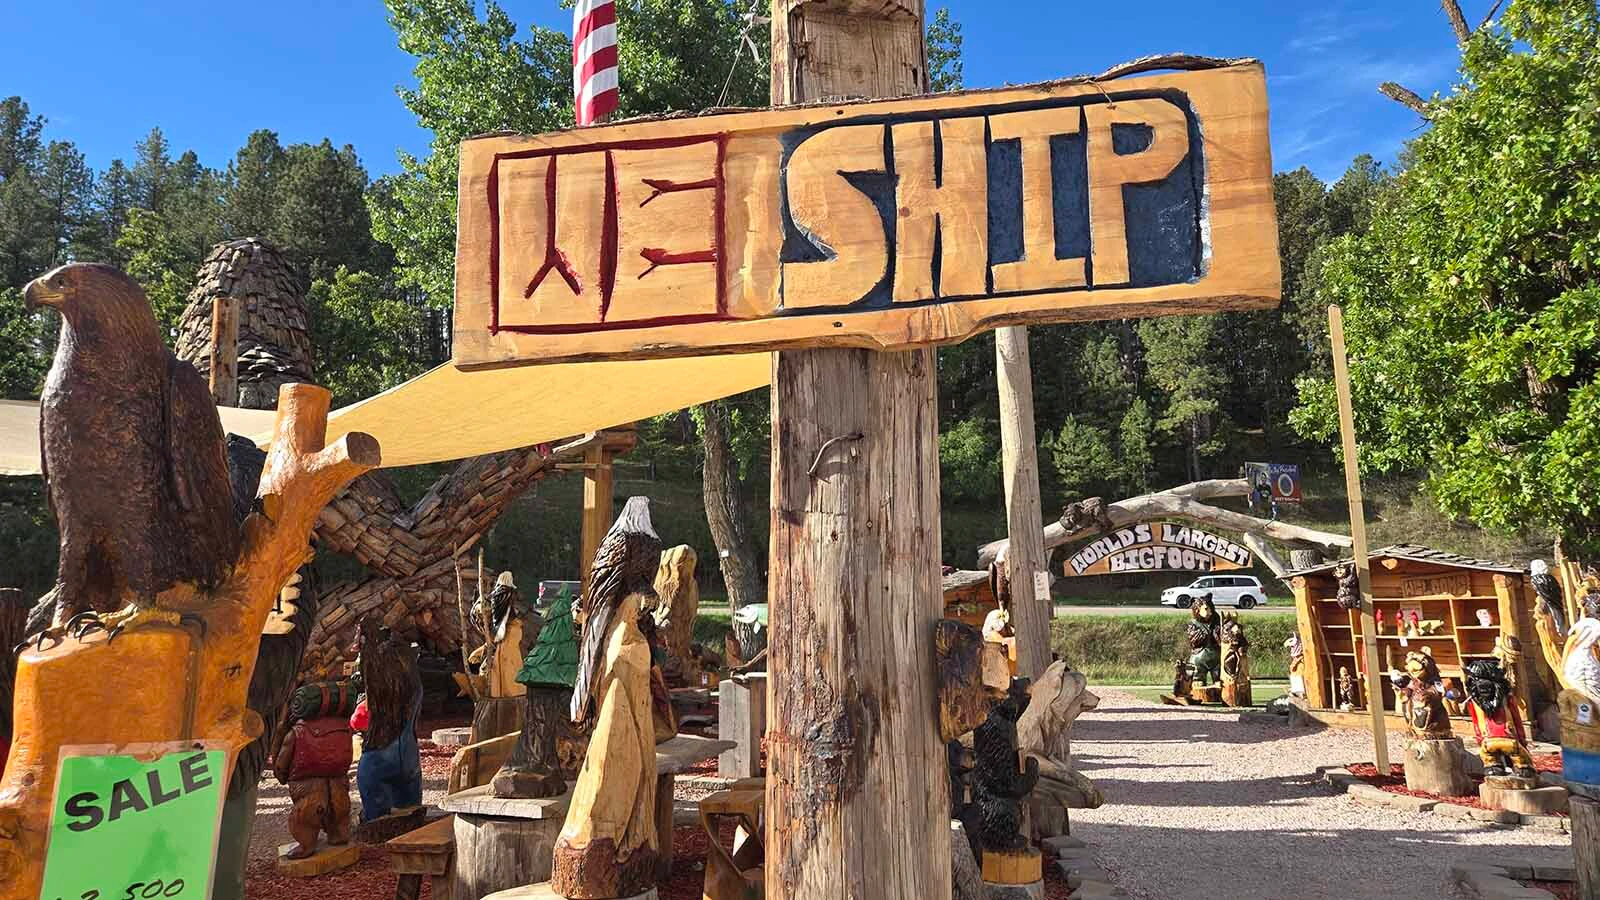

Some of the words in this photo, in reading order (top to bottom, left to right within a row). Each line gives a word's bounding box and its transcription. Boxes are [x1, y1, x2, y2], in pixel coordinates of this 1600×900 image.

[491, 133, 727, 333] WE
[784, 97, 1192, 309] SHIP
[1070, 524, 1151, 574] WORLDS
[1162, 524, 1249, 566] LARGEST
[1111, 547, 1217, 571] BIGFOOT!
[64, 751, 213, 832] SALE
